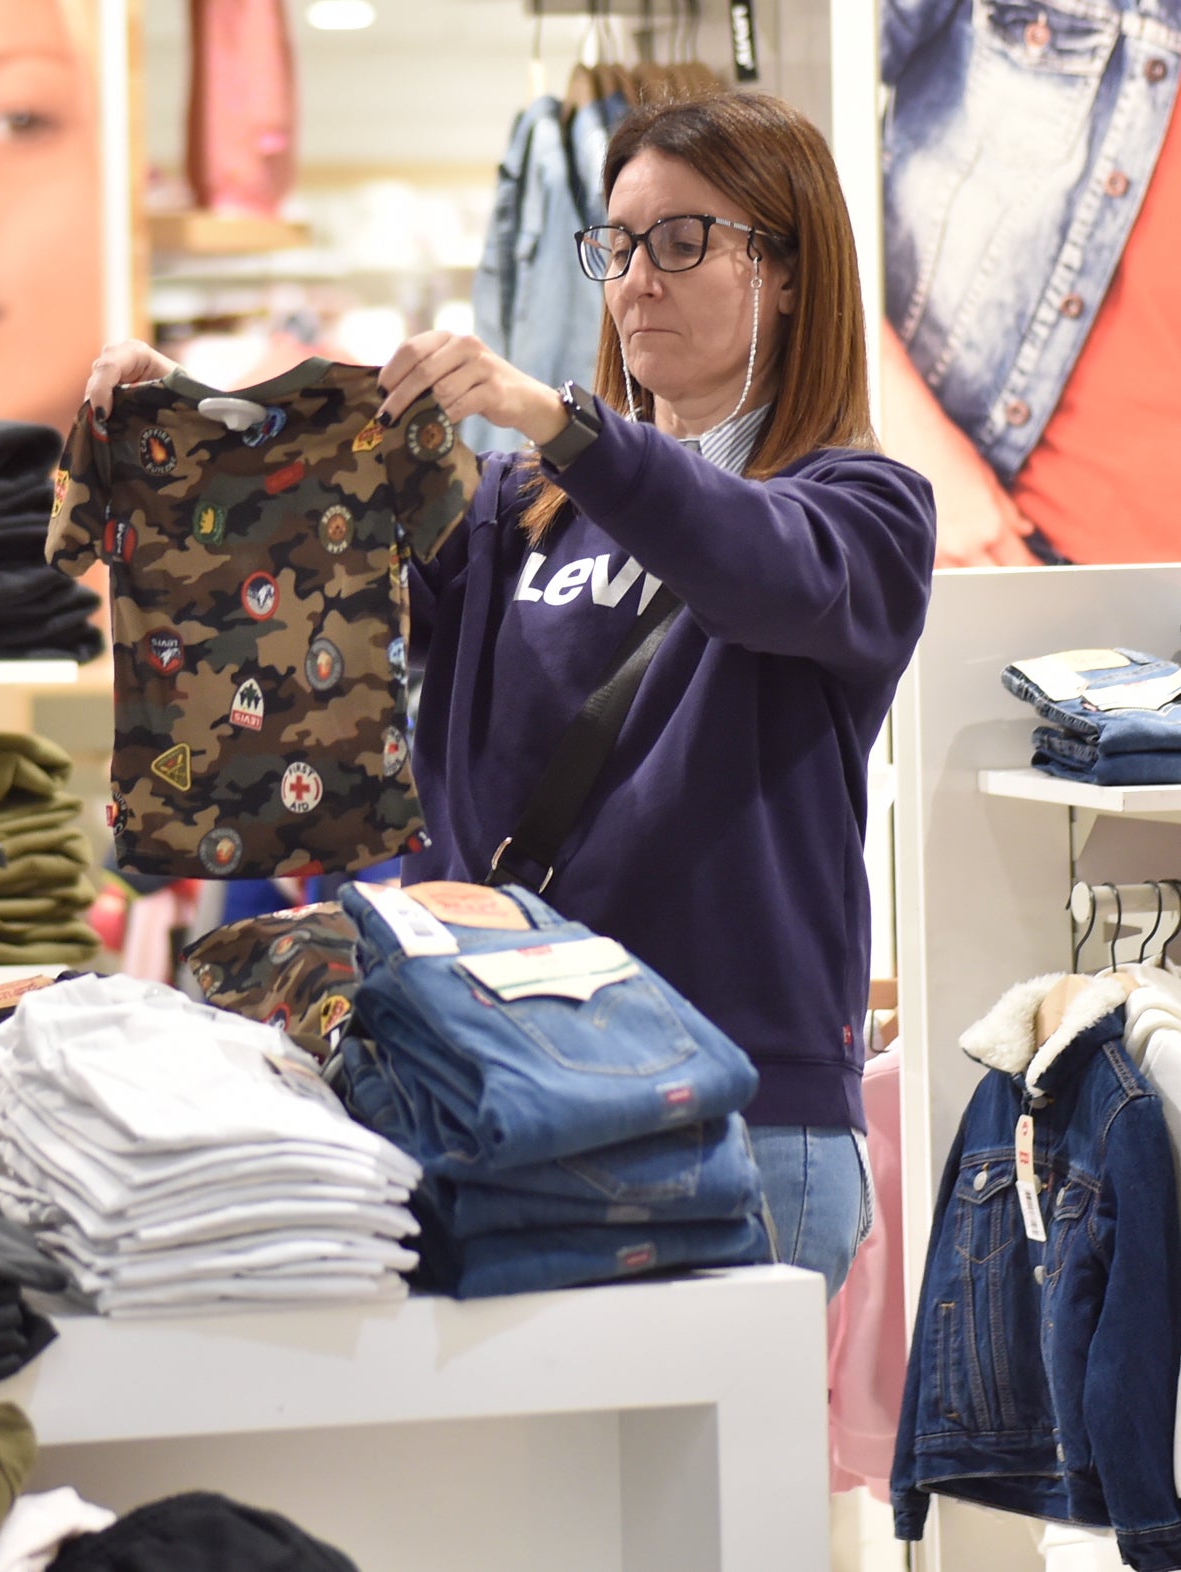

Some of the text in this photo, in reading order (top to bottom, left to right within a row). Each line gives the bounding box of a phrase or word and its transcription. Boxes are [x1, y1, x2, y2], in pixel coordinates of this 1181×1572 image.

[234, 712, 260, 725] LEVIS
[288, 763, 315, 777] FIRST
[290, 802, 309, 812] AID
